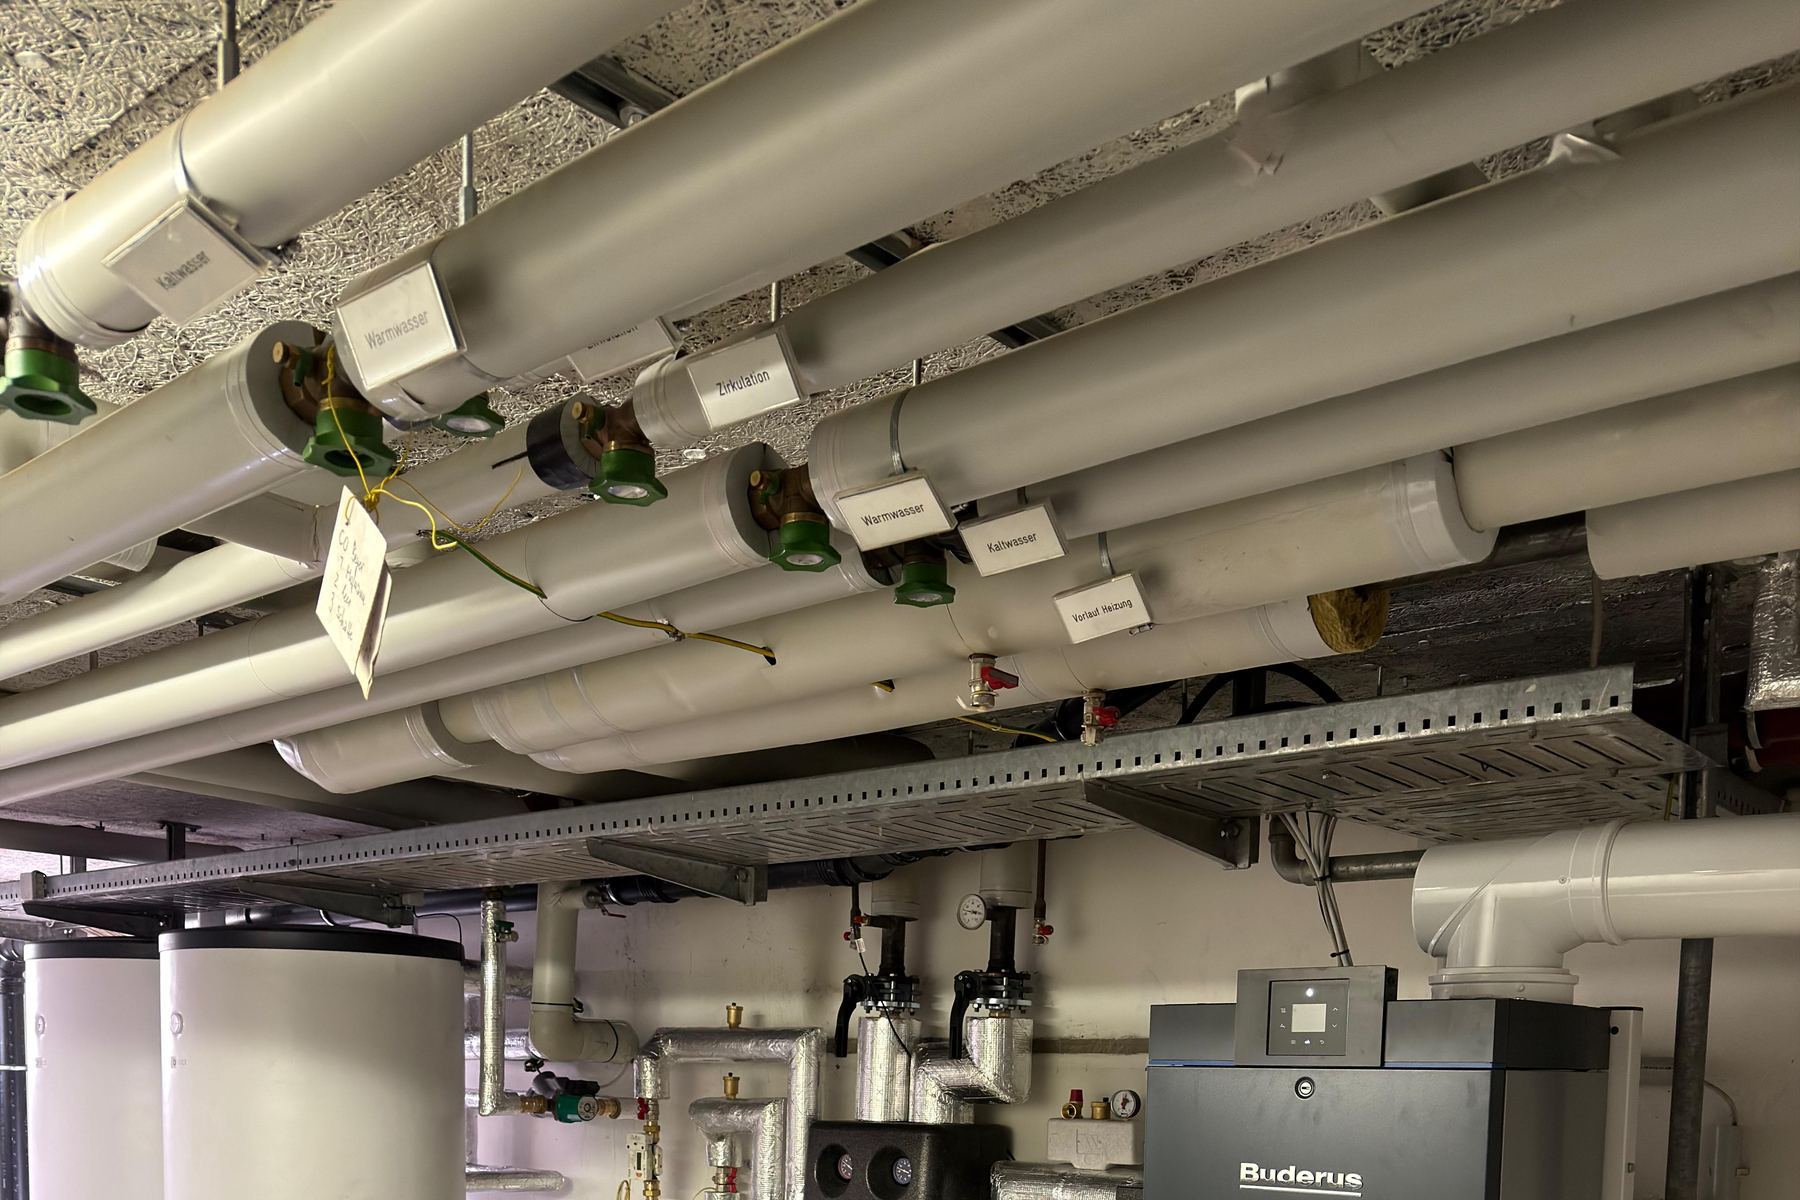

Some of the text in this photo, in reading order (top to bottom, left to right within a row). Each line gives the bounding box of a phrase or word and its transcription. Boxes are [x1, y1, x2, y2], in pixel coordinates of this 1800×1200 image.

[153, 250, 210, 291] Kaltwasser
[364, 311, 428, 350] Warmwasser
[716, 370, 770, 396] Zirkulation
[861, 503, 925, 526] Warmwasser
[987, 533, 1037, 553] Kaltwasser
[1072, 599, 1133, 622] Vorlauf Heizung
[1240, 1162, 1362, 1190] Buderus
